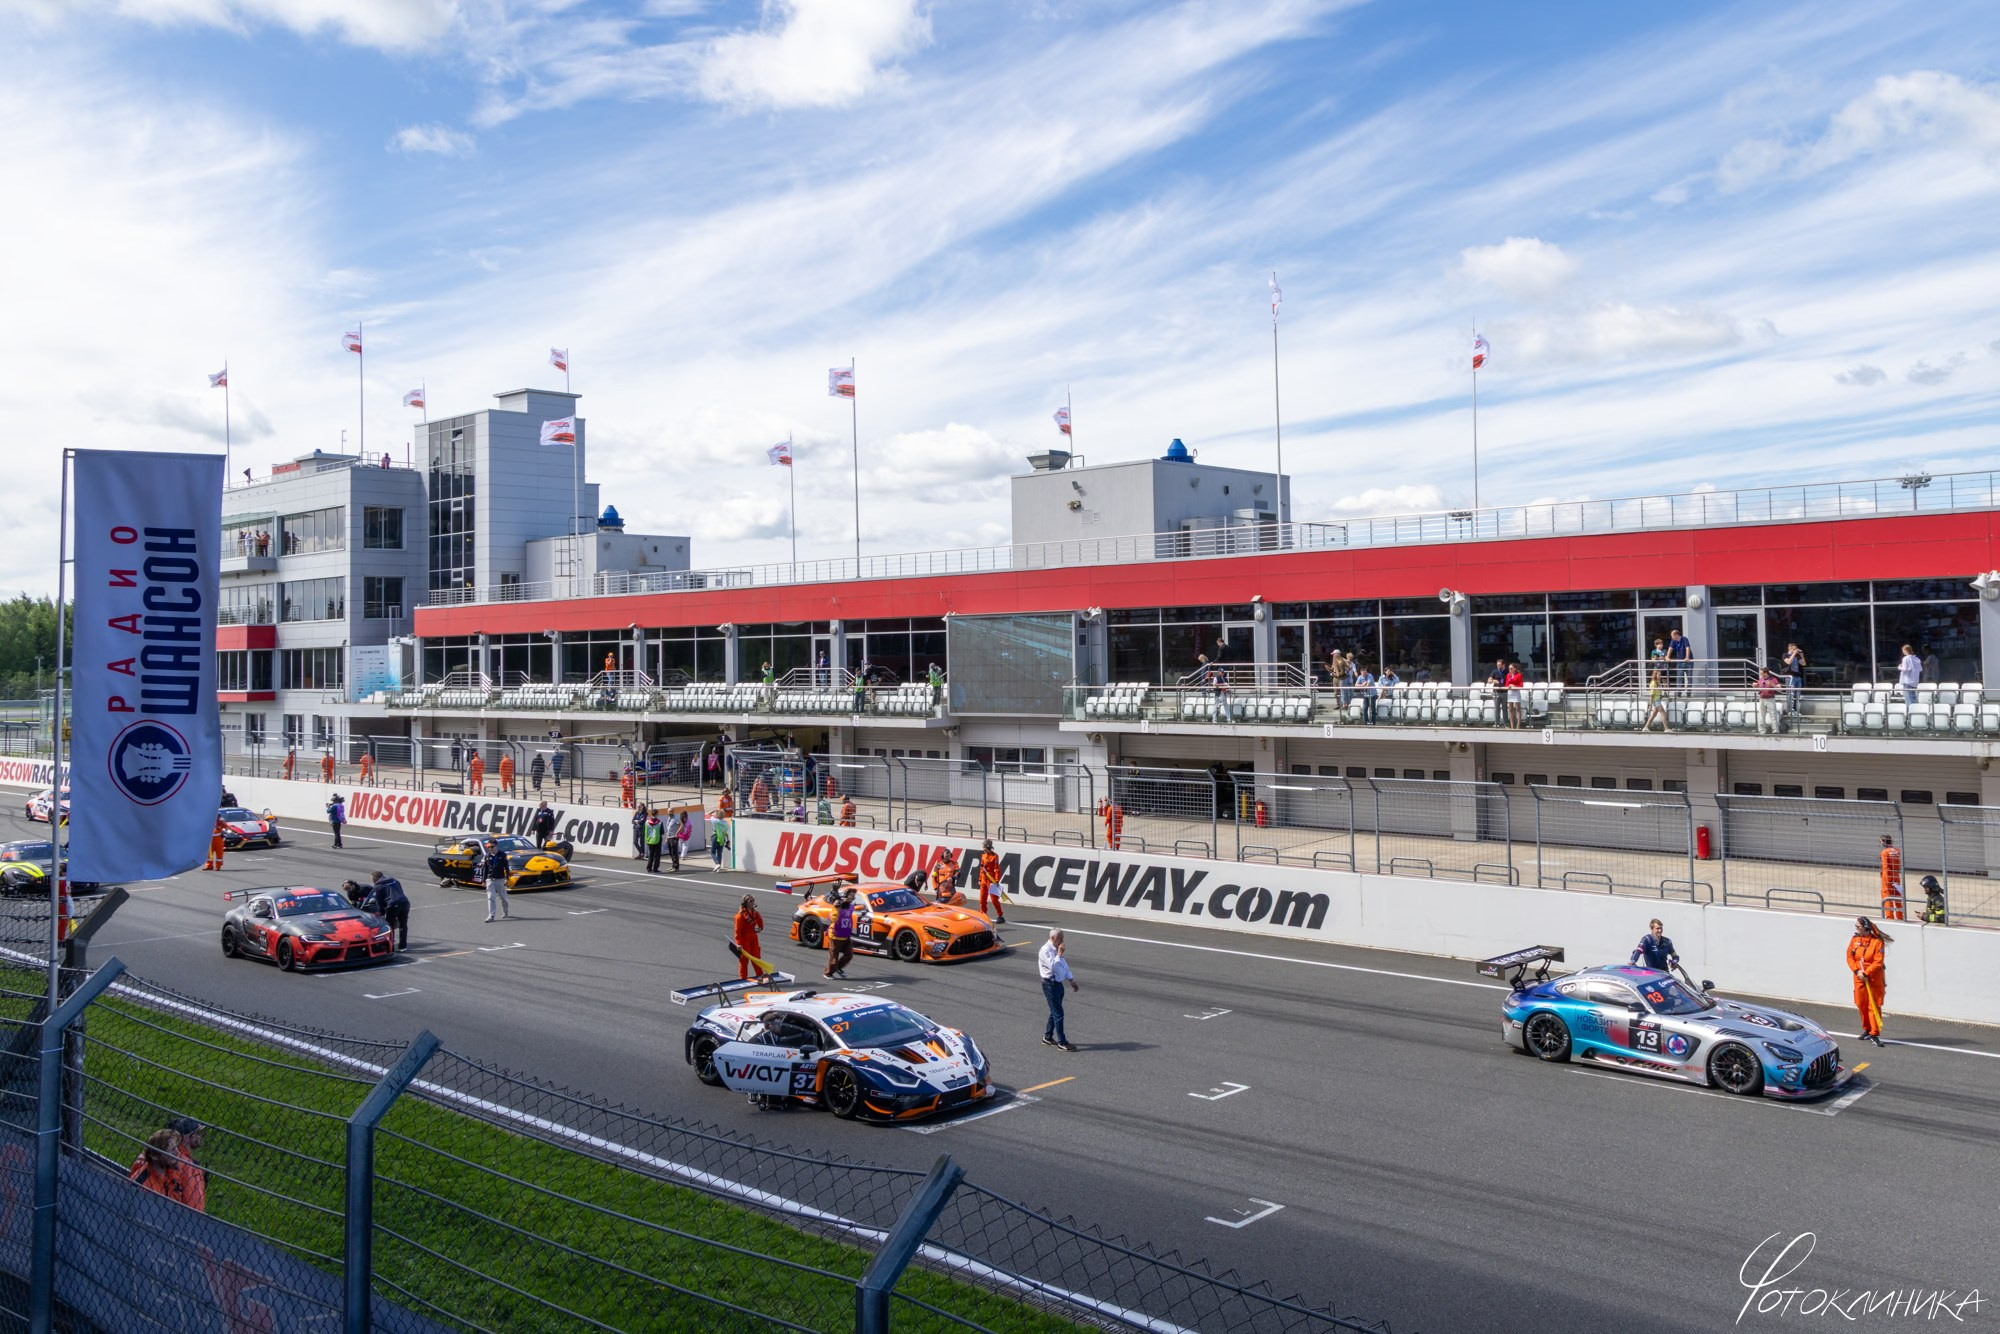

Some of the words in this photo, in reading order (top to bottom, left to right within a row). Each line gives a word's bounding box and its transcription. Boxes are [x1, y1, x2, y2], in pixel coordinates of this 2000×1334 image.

[107, 525, 142, 712] РАДИО
[140, 527, 201, 715] ШАНСОН
[1326, 726, 1331, 737] 8
[1545, 731, 1550, 743] 9
[1814, 737, 1826, 750] 10
[870, 897, 885, 906] 10
[858, 923, 870, 934] 10
[1647, 991, 1664, 1003] 13
[1576, 1014, 1614, 1028] НОБАЗИТ
[1639, 1020, 1655, 1028] АВТО
[832, 1021, 850, 1034] 37
[1581, 1023, 1609, 1035] ФОРТЕ
[1636, 1030, 1658, 1046] 13
[752, 1050, 786, 1059] TERAPLAN
[794, 1073, 816, 1089] 37
